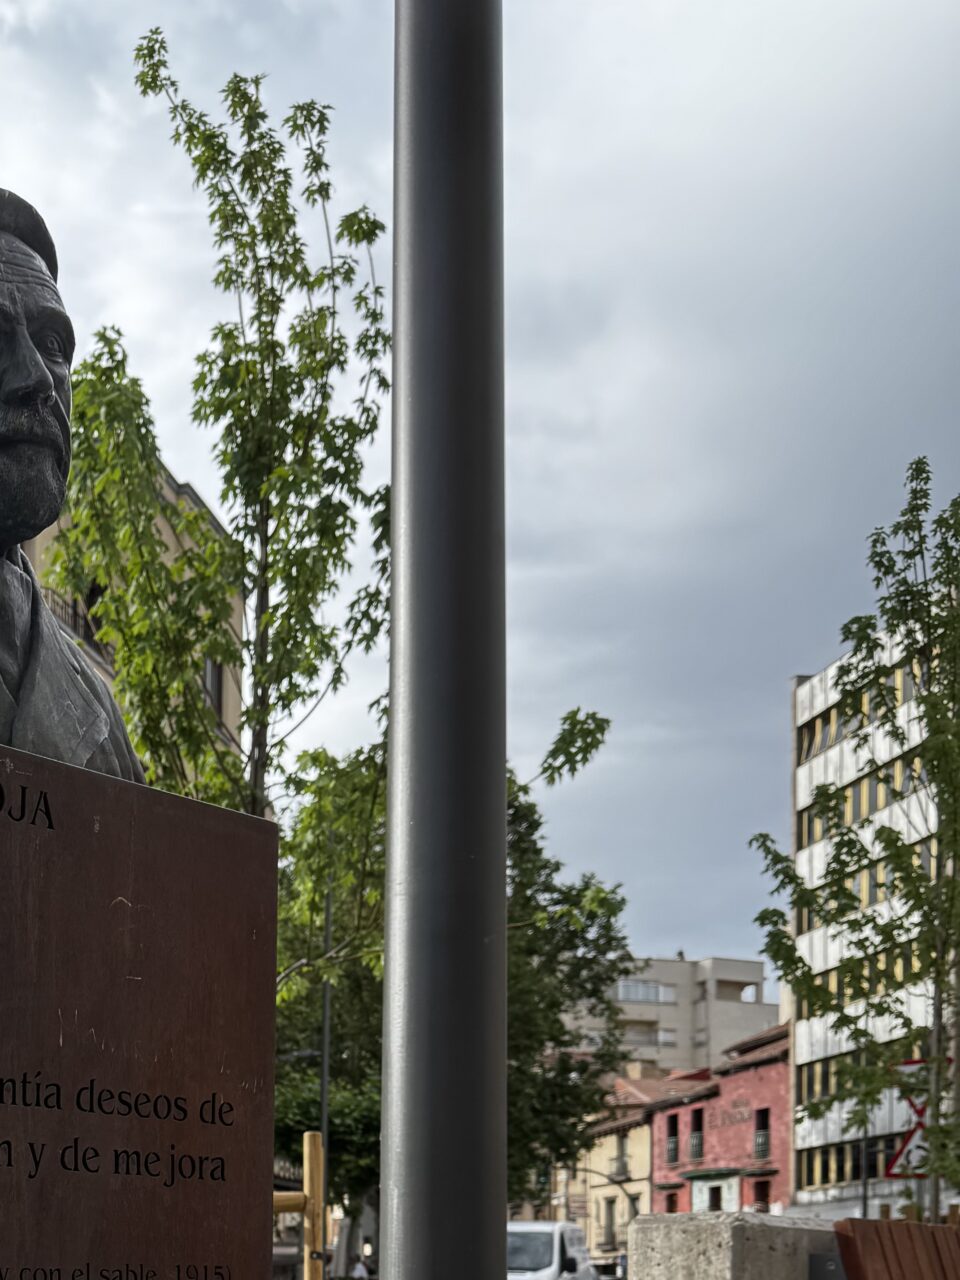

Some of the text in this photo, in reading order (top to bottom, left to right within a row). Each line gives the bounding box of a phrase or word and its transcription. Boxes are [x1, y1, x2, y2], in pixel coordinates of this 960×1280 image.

[75, 1078, 188, 1122] deseos
[198, 1092, 235, 1127] de
[27, 1140, 47, 1179] y
[59, 1136, 100, 1174] de
[112, 1143, 227, 1188] mejora
